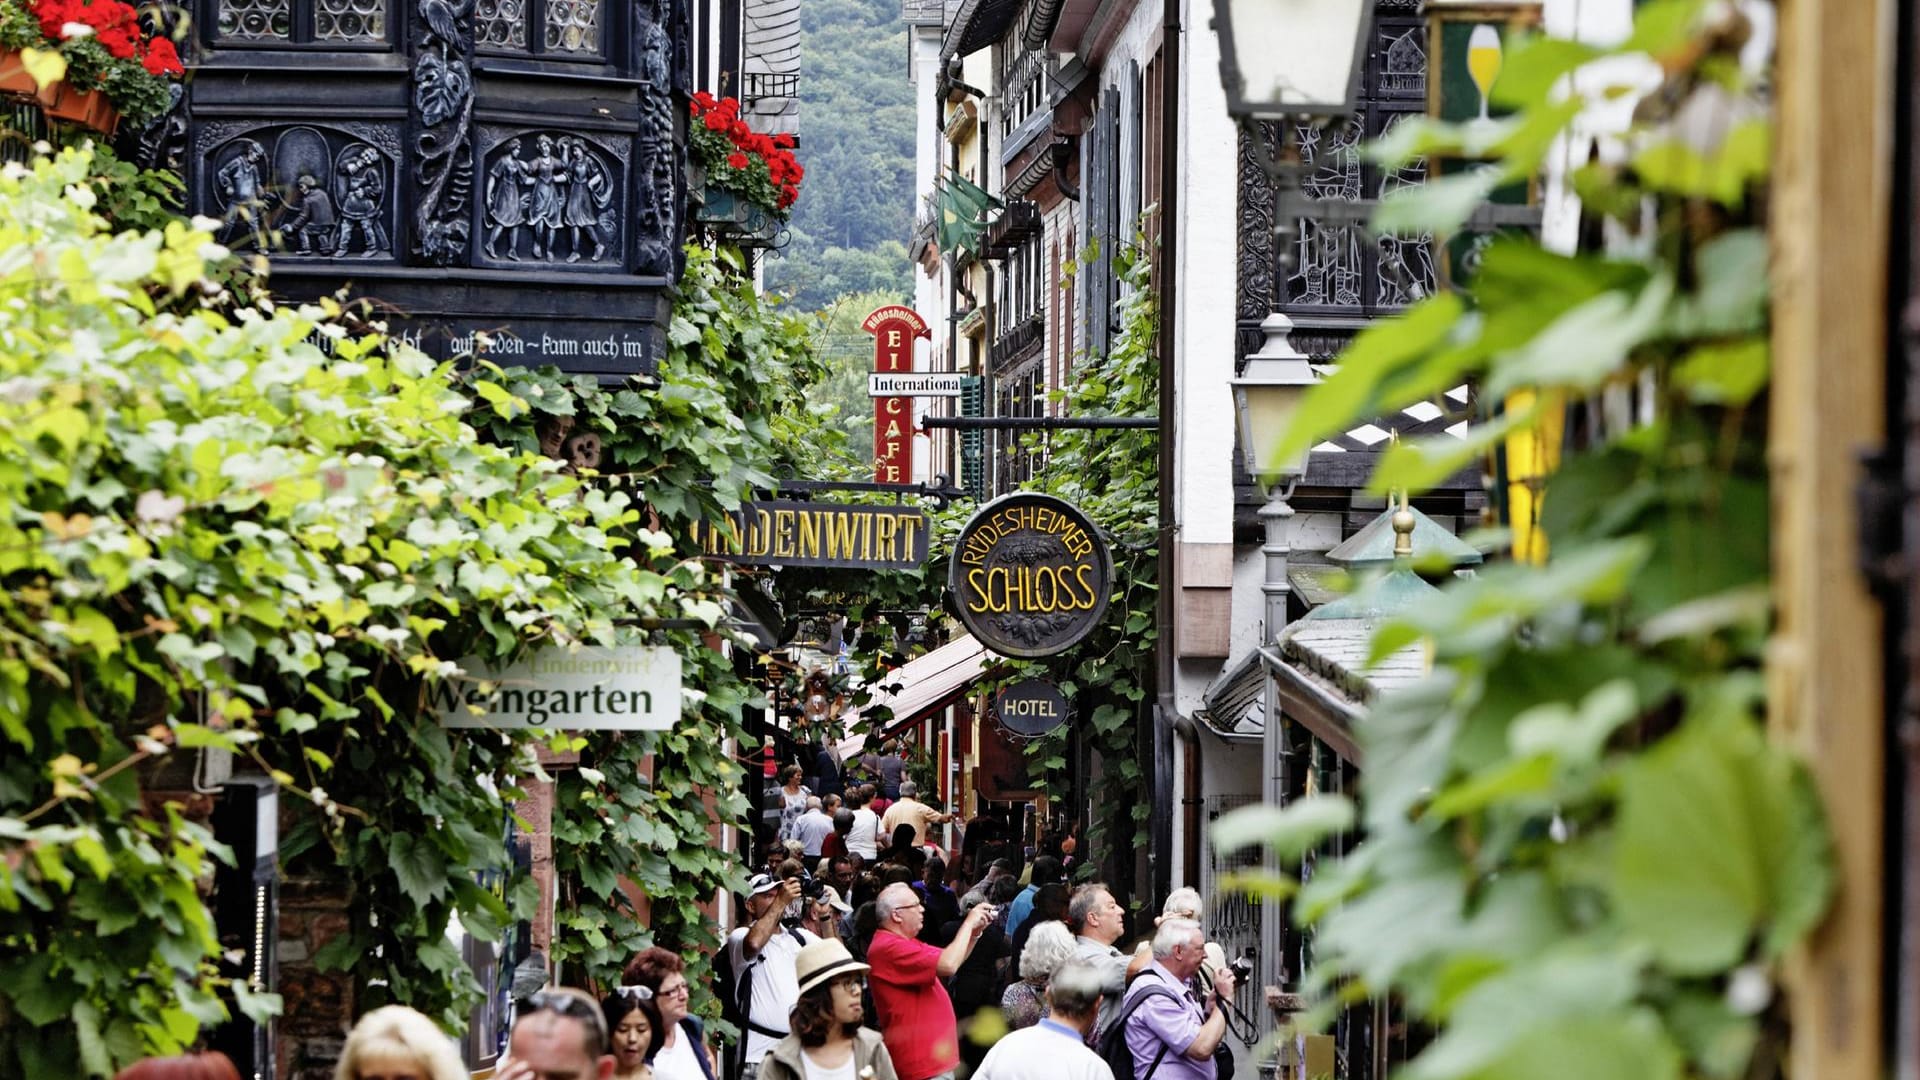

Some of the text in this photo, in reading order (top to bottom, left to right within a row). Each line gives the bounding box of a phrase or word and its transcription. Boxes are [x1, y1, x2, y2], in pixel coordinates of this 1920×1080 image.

[866, 308, 922, 331] Rüdesheimer
[482, 332, 525, 355] rden
[583, 334, 619, 359] auch
[623, 334, 643, 358] im
[874, 376, 961, 391] Internationa
[961, 506, 1093, 566] RÜDESHEIMER
[968, 564, 1096, 613] SCHLOSS
[1004, 699, 1058, 717] HOTEL
